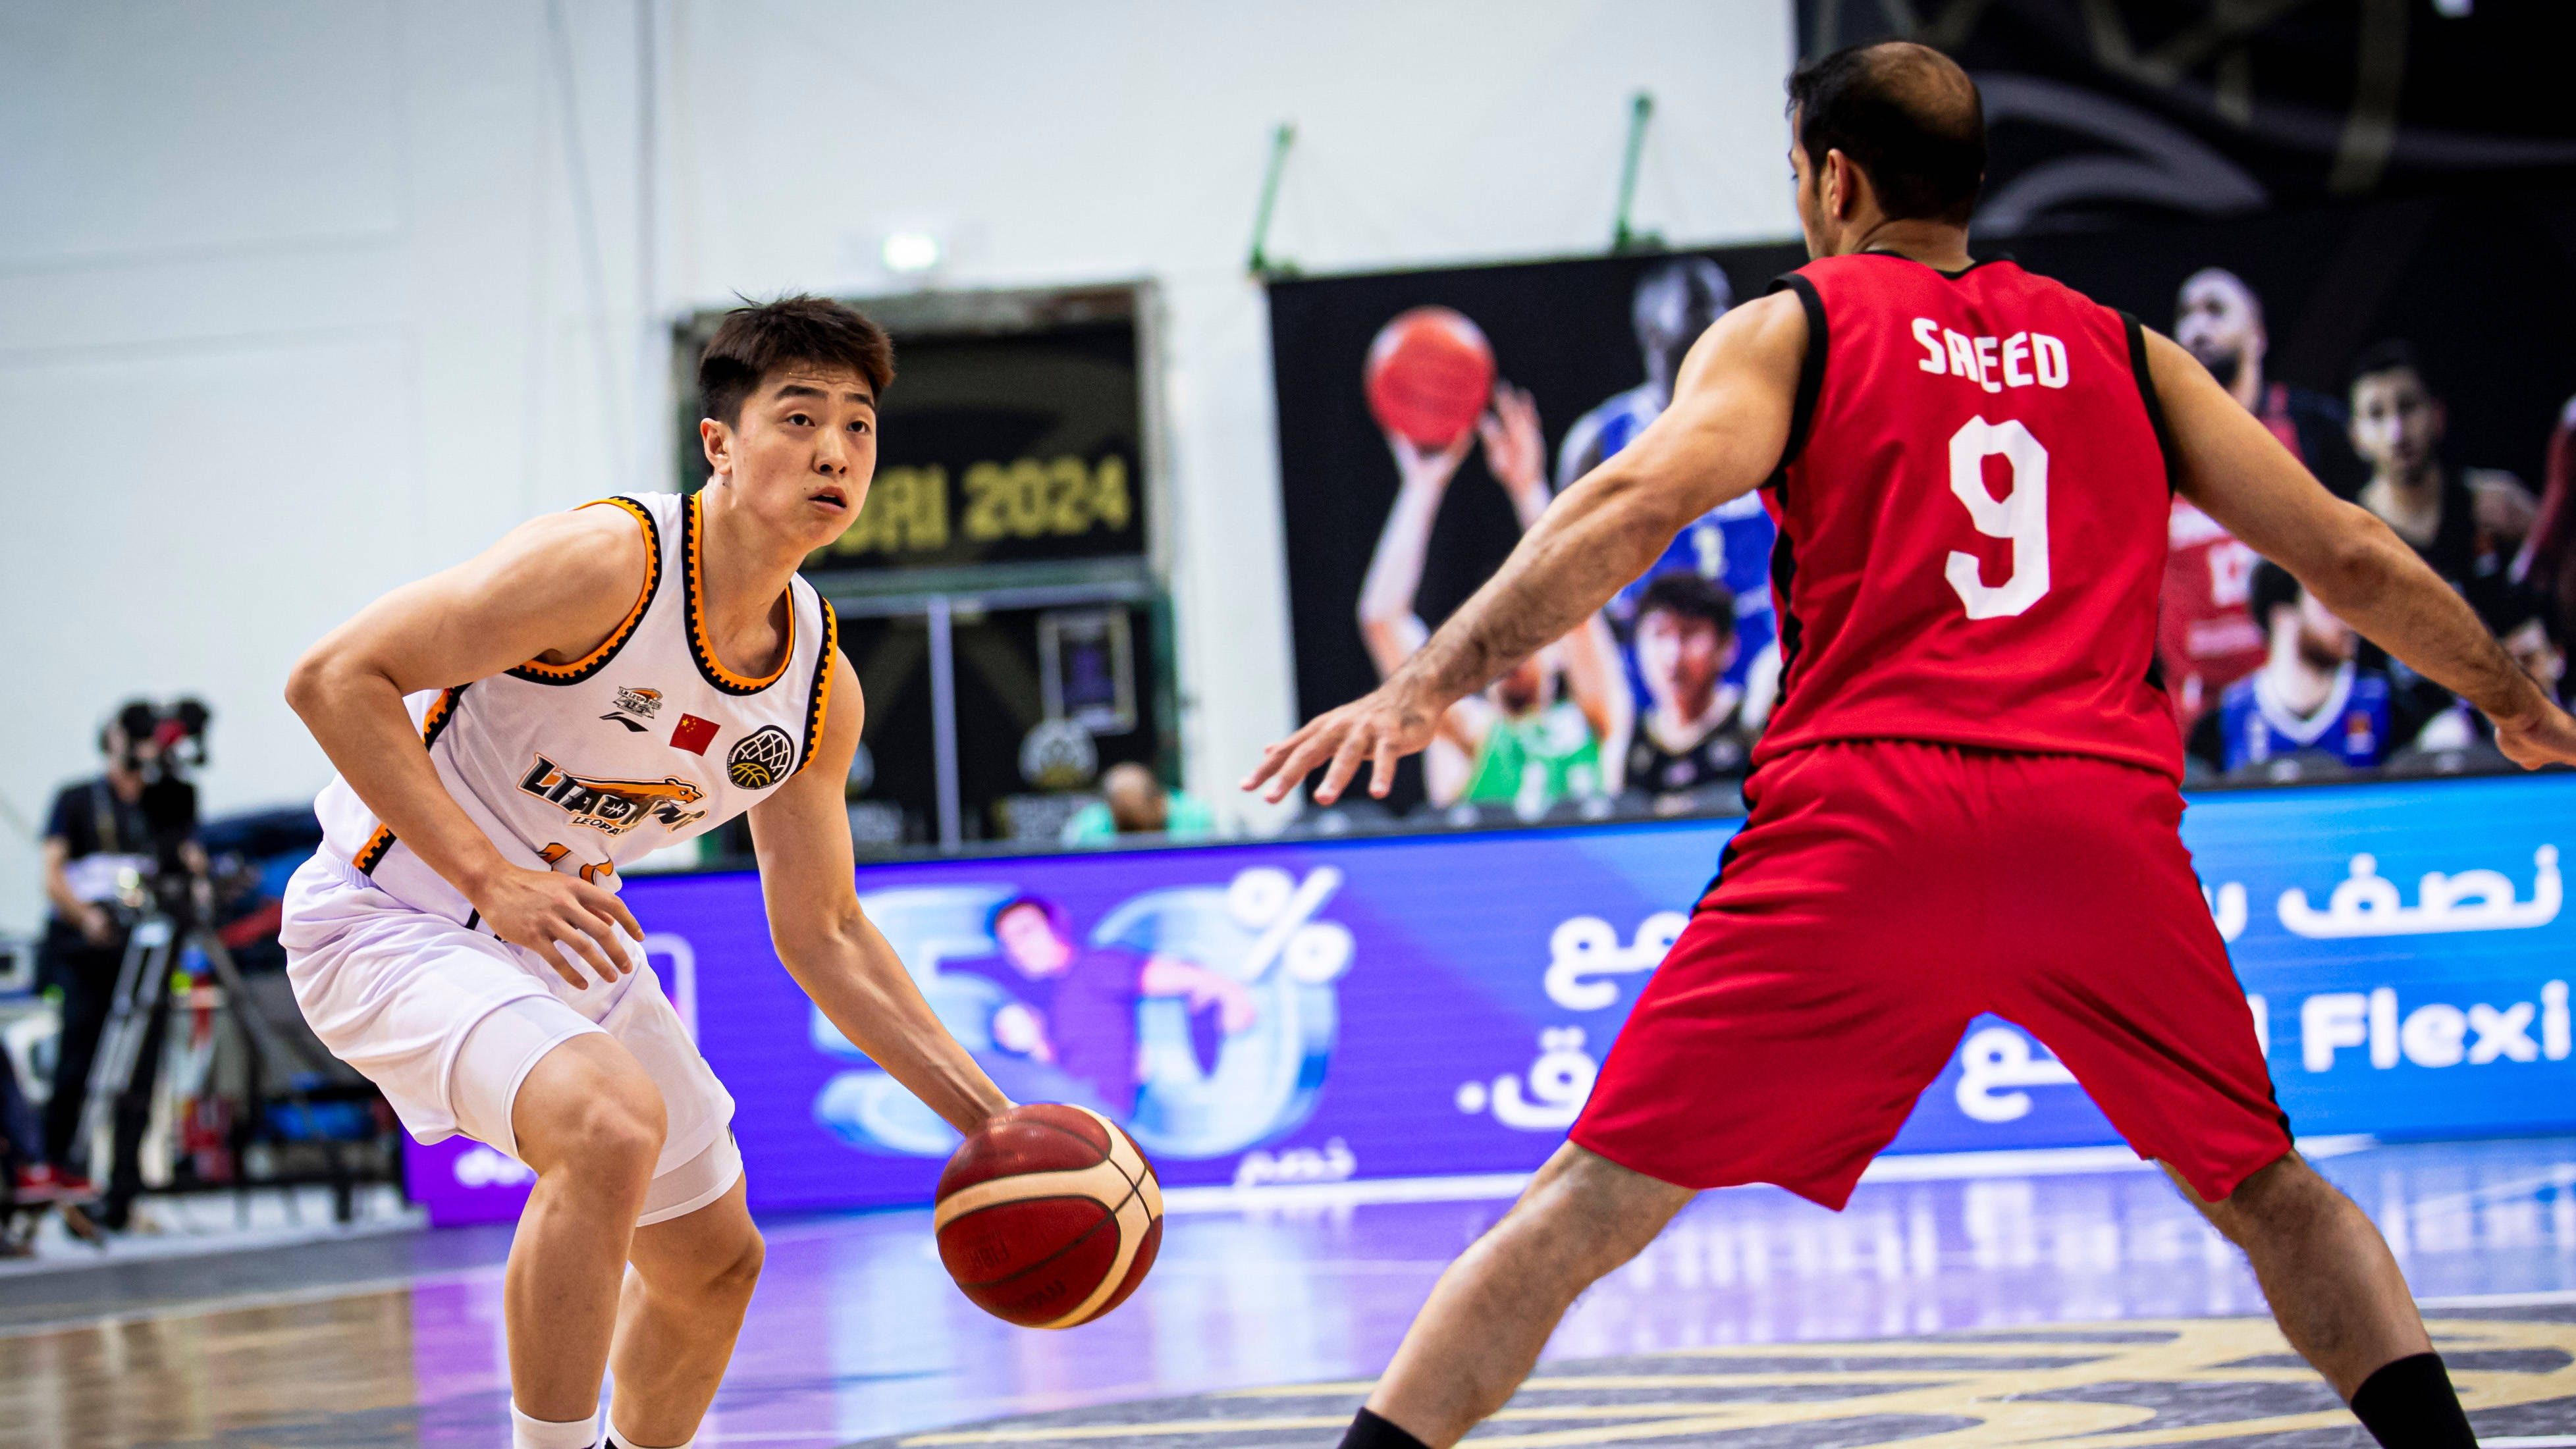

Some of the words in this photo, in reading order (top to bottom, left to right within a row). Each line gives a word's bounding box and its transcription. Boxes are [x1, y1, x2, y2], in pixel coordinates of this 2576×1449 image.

[1912, 317, 2070, 393] SAEED
[962, 456, 1130, 542] 2024
[1945, 415, 2051, 620] 9
[2277, 843, 2563, 940] نصف
[2301, 980, 2573, 1074] Flexi
